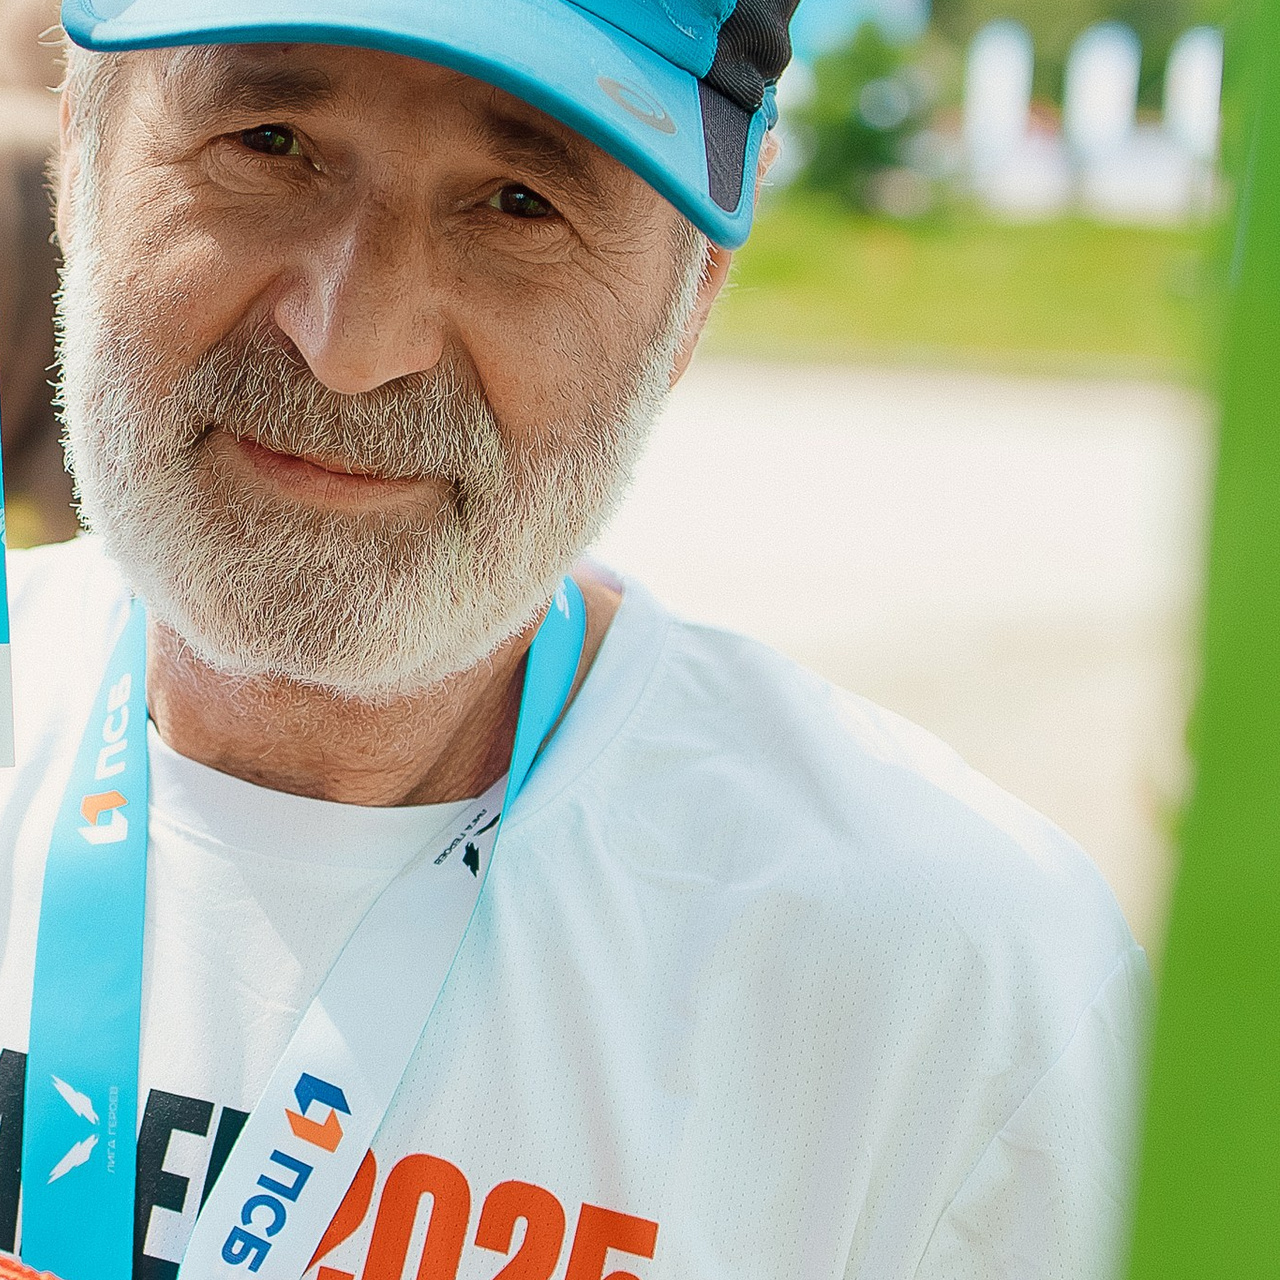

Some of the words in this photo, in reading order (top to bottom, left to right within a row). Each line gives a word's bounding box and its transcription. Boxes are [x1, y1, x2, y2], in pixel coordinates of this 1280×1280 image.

[433, 832, 467, 866] ГЕРОЕВ
[108, 1086, 119, 1136] ГЕРОЕВ
[106, 1140, 116, 1174] ЛИГА
[221, 1149, 314, 1273] ПСБ
